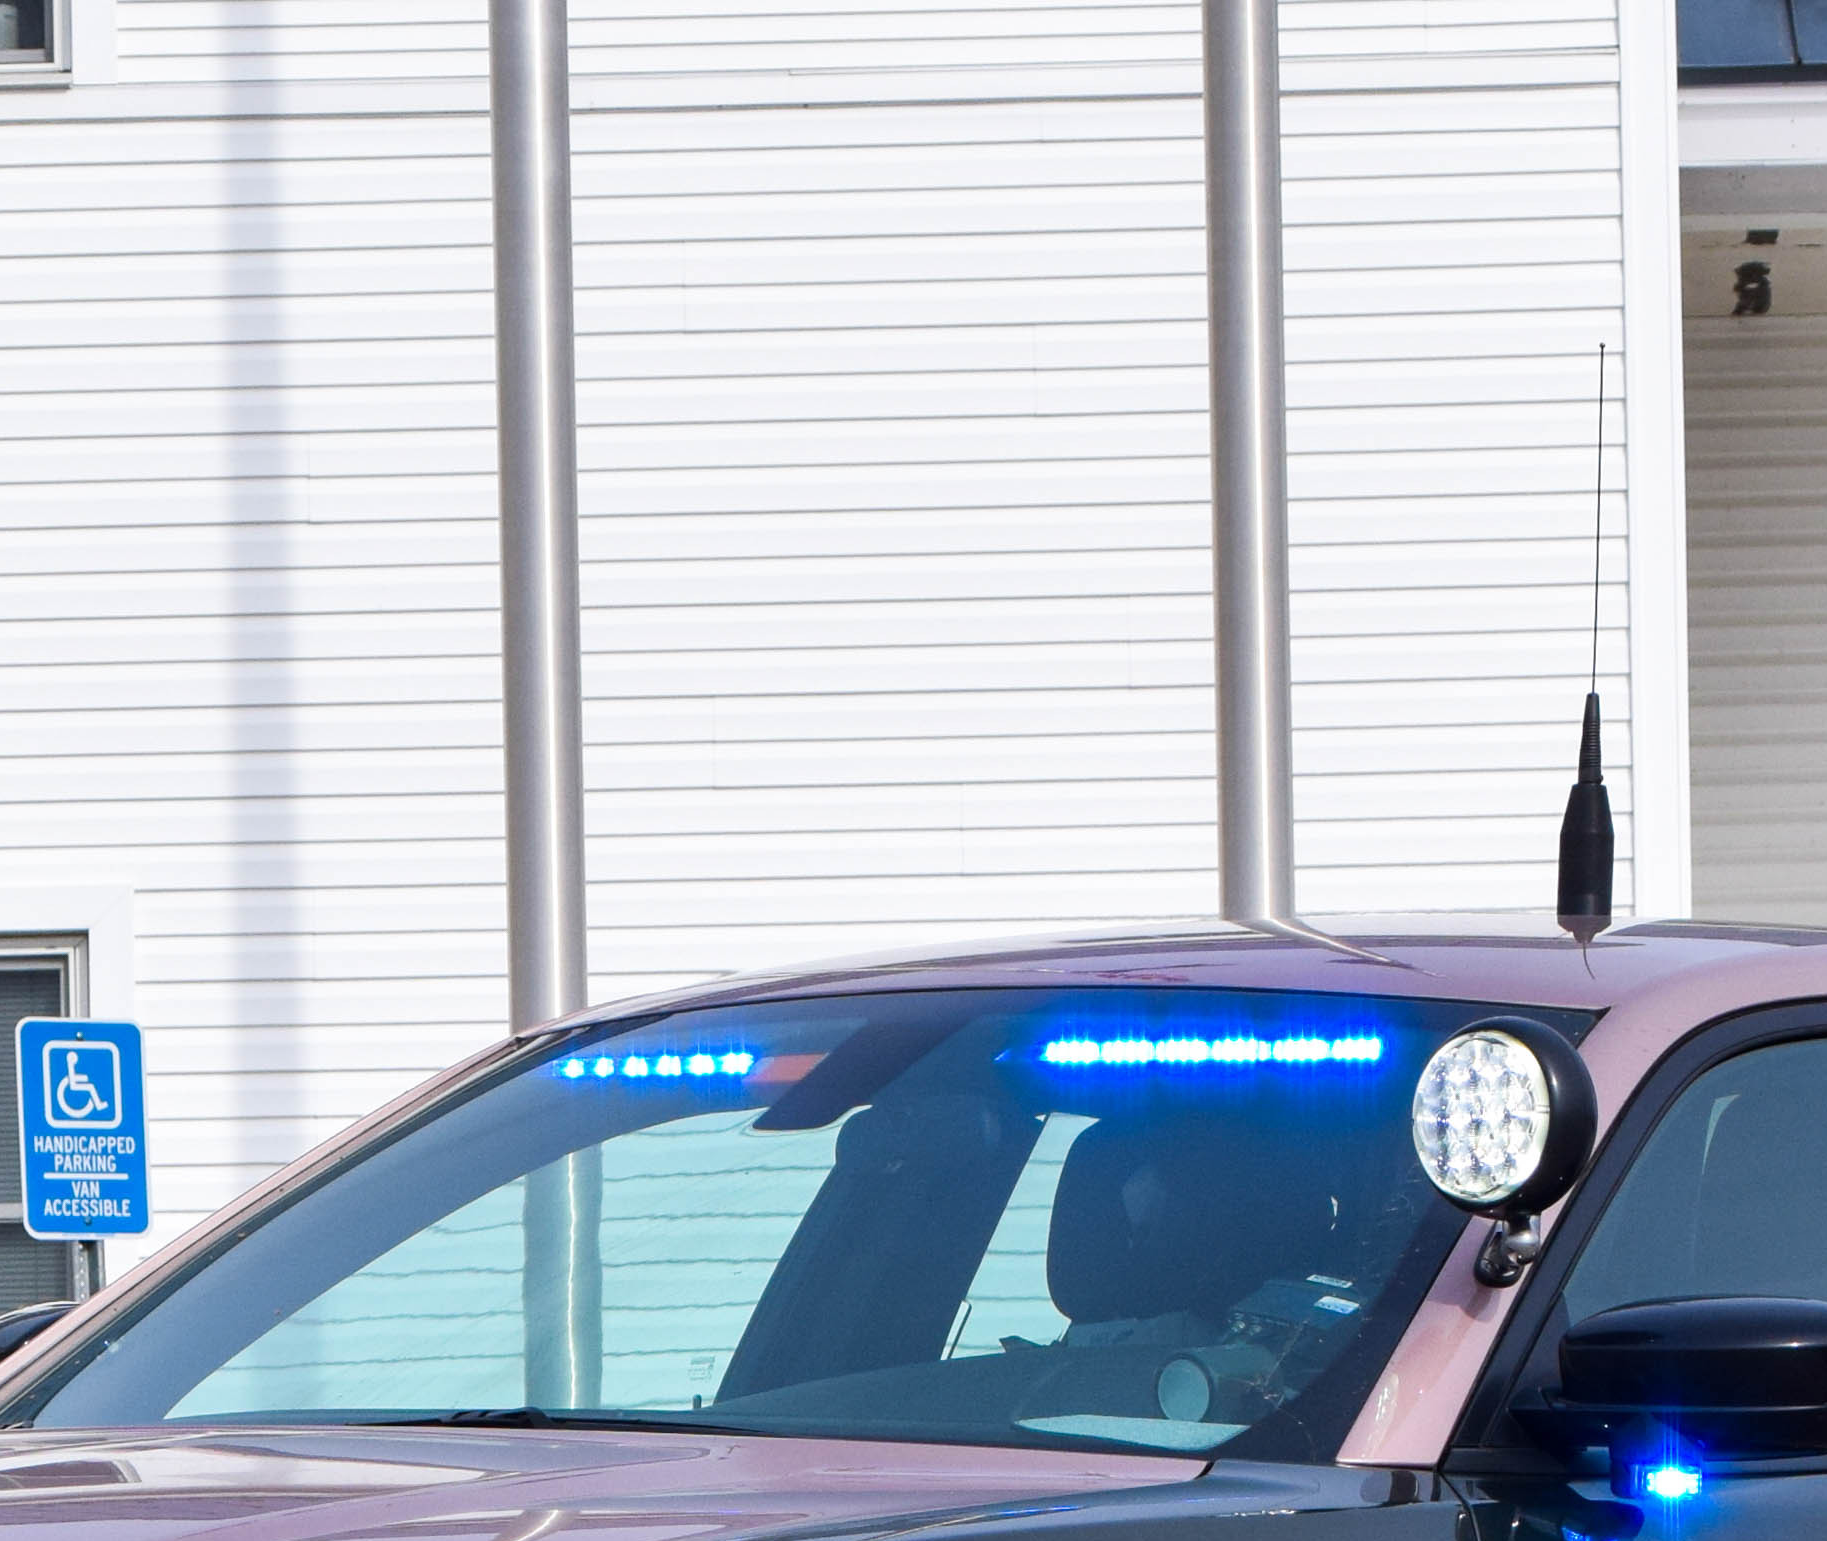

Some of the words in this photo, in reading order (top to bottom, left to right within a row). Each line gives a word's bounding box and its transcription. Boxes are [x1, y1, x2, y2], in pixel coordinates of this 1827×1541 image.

[34, 1136, 135, 1154] HANDICAPPED
[54, 1155, 116, 1173] PARKING
[71, 1181, 100, 1198] VAN
[44, 1199, 131, 1217] ACCESSIBLE
